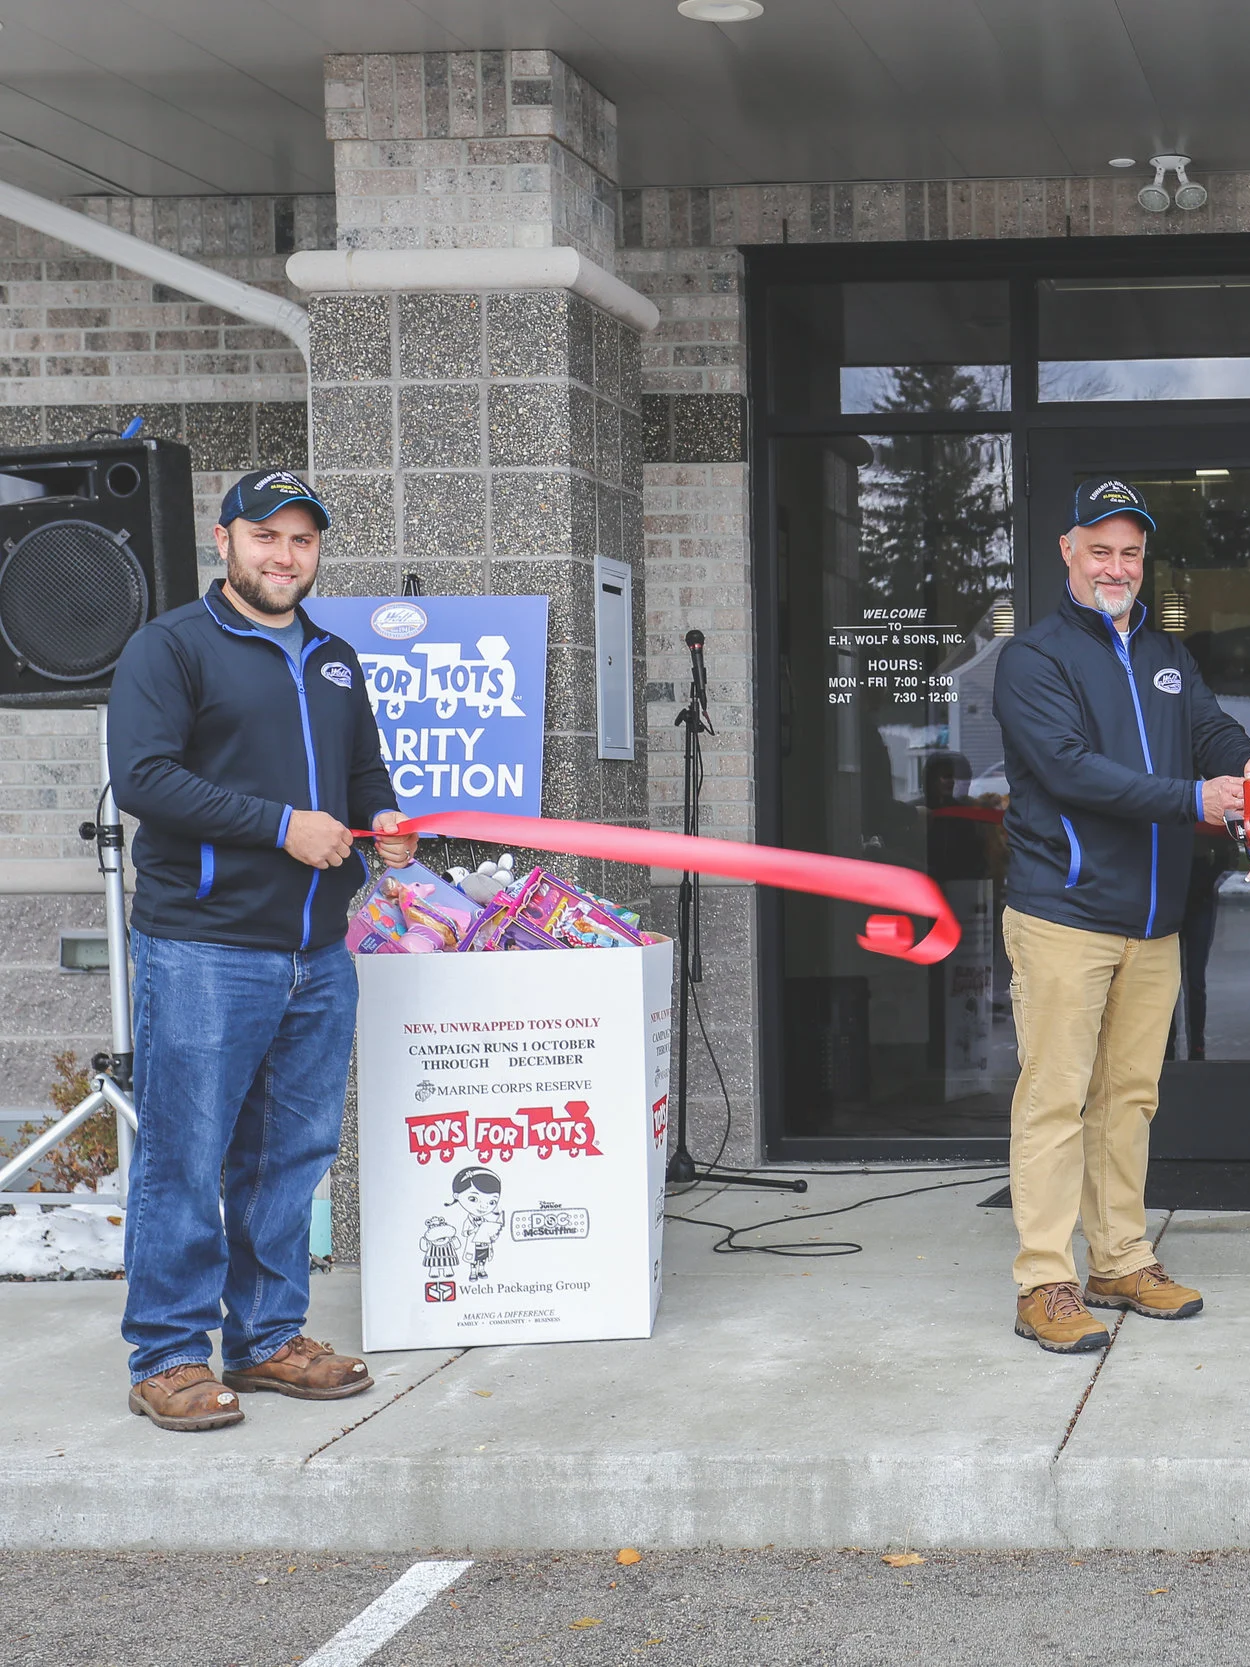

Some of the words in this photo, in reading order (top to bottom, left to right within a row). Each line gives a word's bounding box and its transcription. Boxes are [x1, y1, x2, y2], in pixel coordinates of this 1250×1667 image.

[863, 608, 927, 619] WELCOME
[888, 622, 902, 631] TO
[829, 635, 852, 645] E.H.
[855, 635, 889, 645] WOLF
[892, 635, 900, 645] &
[903, 634, 939, 645] SONS,
[942, 634, 966, 644] INC.
[868, 659, 923, 671] HOURS:
[365, 662, 412, 696] FOR
[431, 664, 504, 700] TOTS
[828, 677, 857, 688] MON
[868, 677, 887, 687] FRI
[894, 677, 918, 687] 7:00
[928, 676, 953, 686] 5:00
[828, 693, 852, 704] SAT
[893, 692, 917, 703] 7:30
[928, 692, 958, 703] 12:00
[380, 728, 485, 761] ARITY
[389, 764, 524, 798] CTION
[403, 1023, 437, 1035] NEW,
[440, 1021, 524, 1034] UNWRAPPED
[528, 1018, 562, 1031] TOYS
[565, 1017, 600, 1029] ONLY
[409, 1043, 480, 1056] CAMPAIGN
[484, 1041, 519, 1054] RUNS
[522, 1042, 528, 1052] 1
[531, 1039, 596, 1052] OCTOBER
[421, 1058, 489, 1071] THROUGH
[509, 1054, 583, 1068] DECEMBER
[437, 1084, 489, 1096] MARINE
[491, 1082, 532, 1094] CORPS
[536, 1080, 592, 1092] RESERVE
[411, 1119, 465, 1147] TOYS
[476, 1122, 518, 1146] FOR
[531, 1121, 588, 1145] TOTS
[531, 1212, 570, 1229] DOC
[459, 1284, 494, 1295] Welch
[497, 1282, 553, 1295] Packaging
[555, 1280, 591, 1292] Group
[463, 1311, 496, 1320] MAKING
[497, 1311, 503, 1319] A
[504, 1309, 555, 1319] DIFFERENCE
